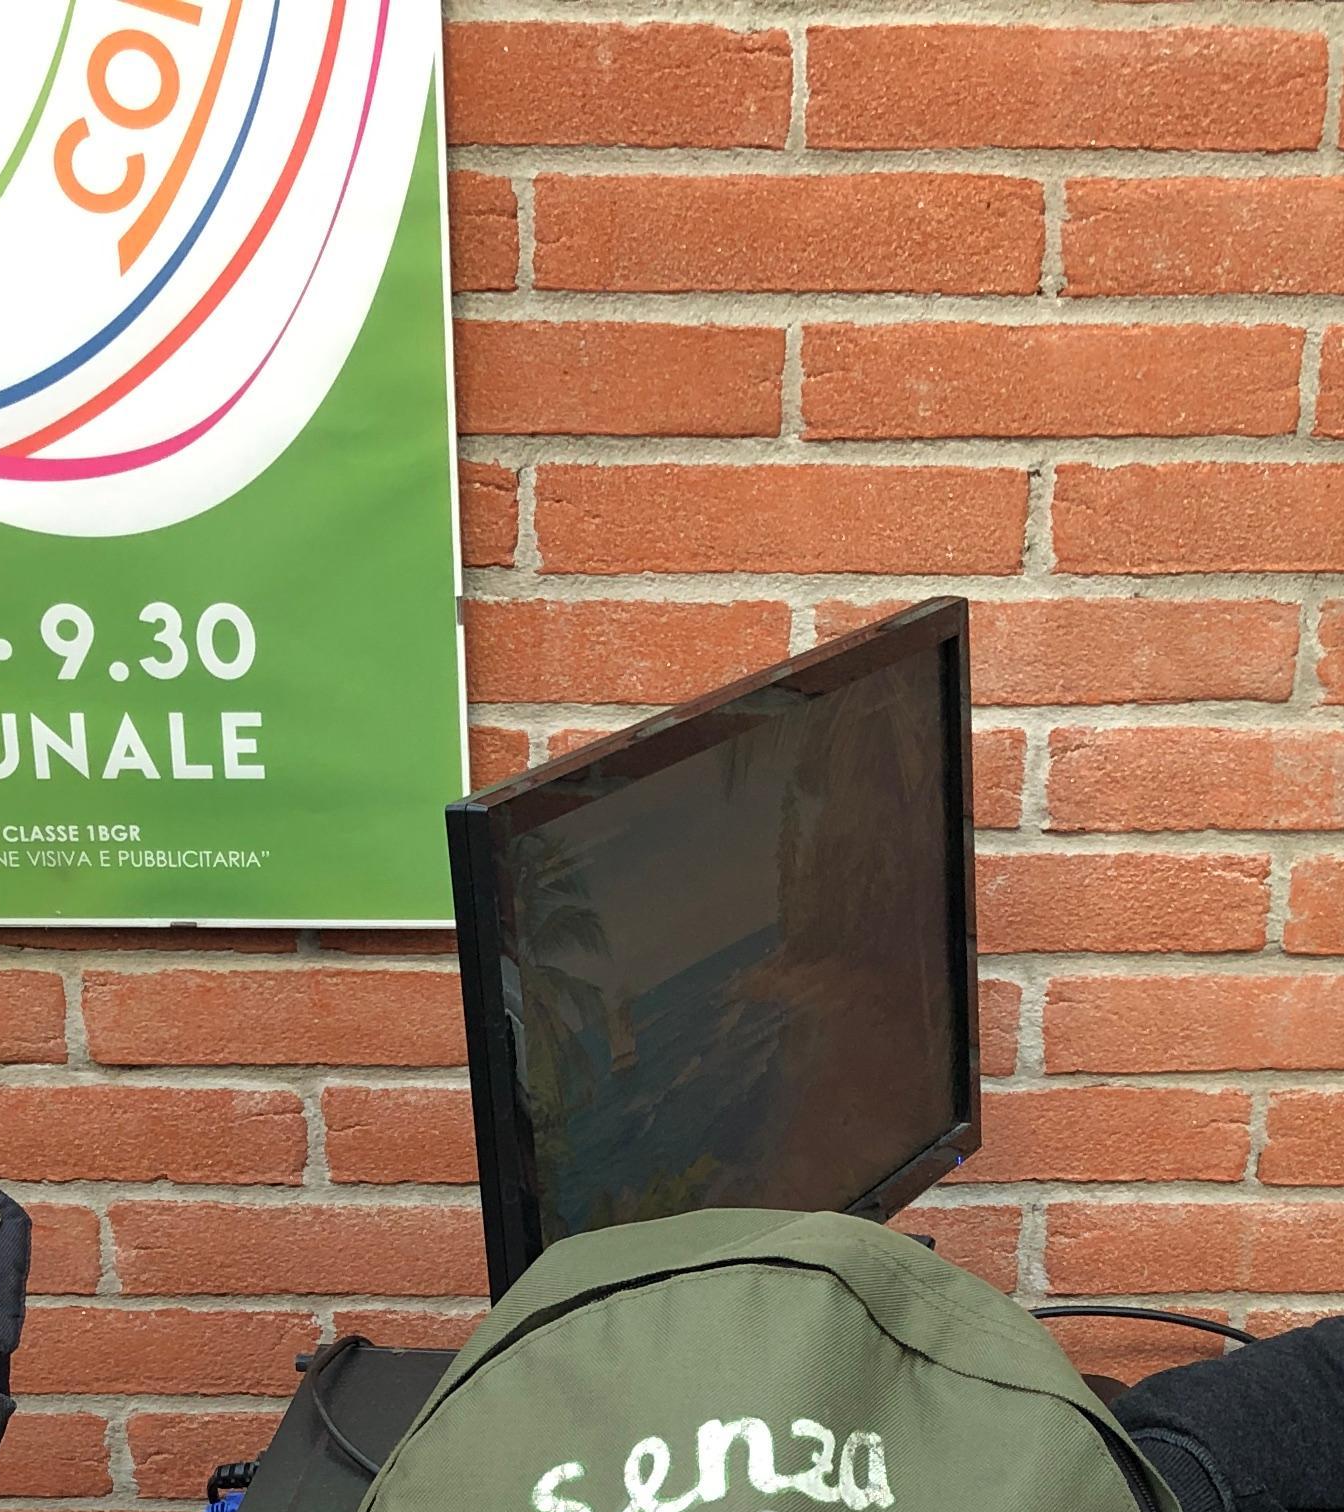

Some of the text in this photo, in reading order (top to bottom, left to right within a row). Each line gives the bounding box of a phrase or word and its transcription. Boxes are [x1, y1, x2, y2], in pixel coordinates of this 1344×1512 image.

[54, 0, 203, 214] CO
[40, 602, 256, 681] 9.30
[2, 825, 79, 843] CLASSE
[86, 824, 141, 842] 1BGR
[26, 850, 93, 867] VISIVA
[99, 850, 111, 867] E
